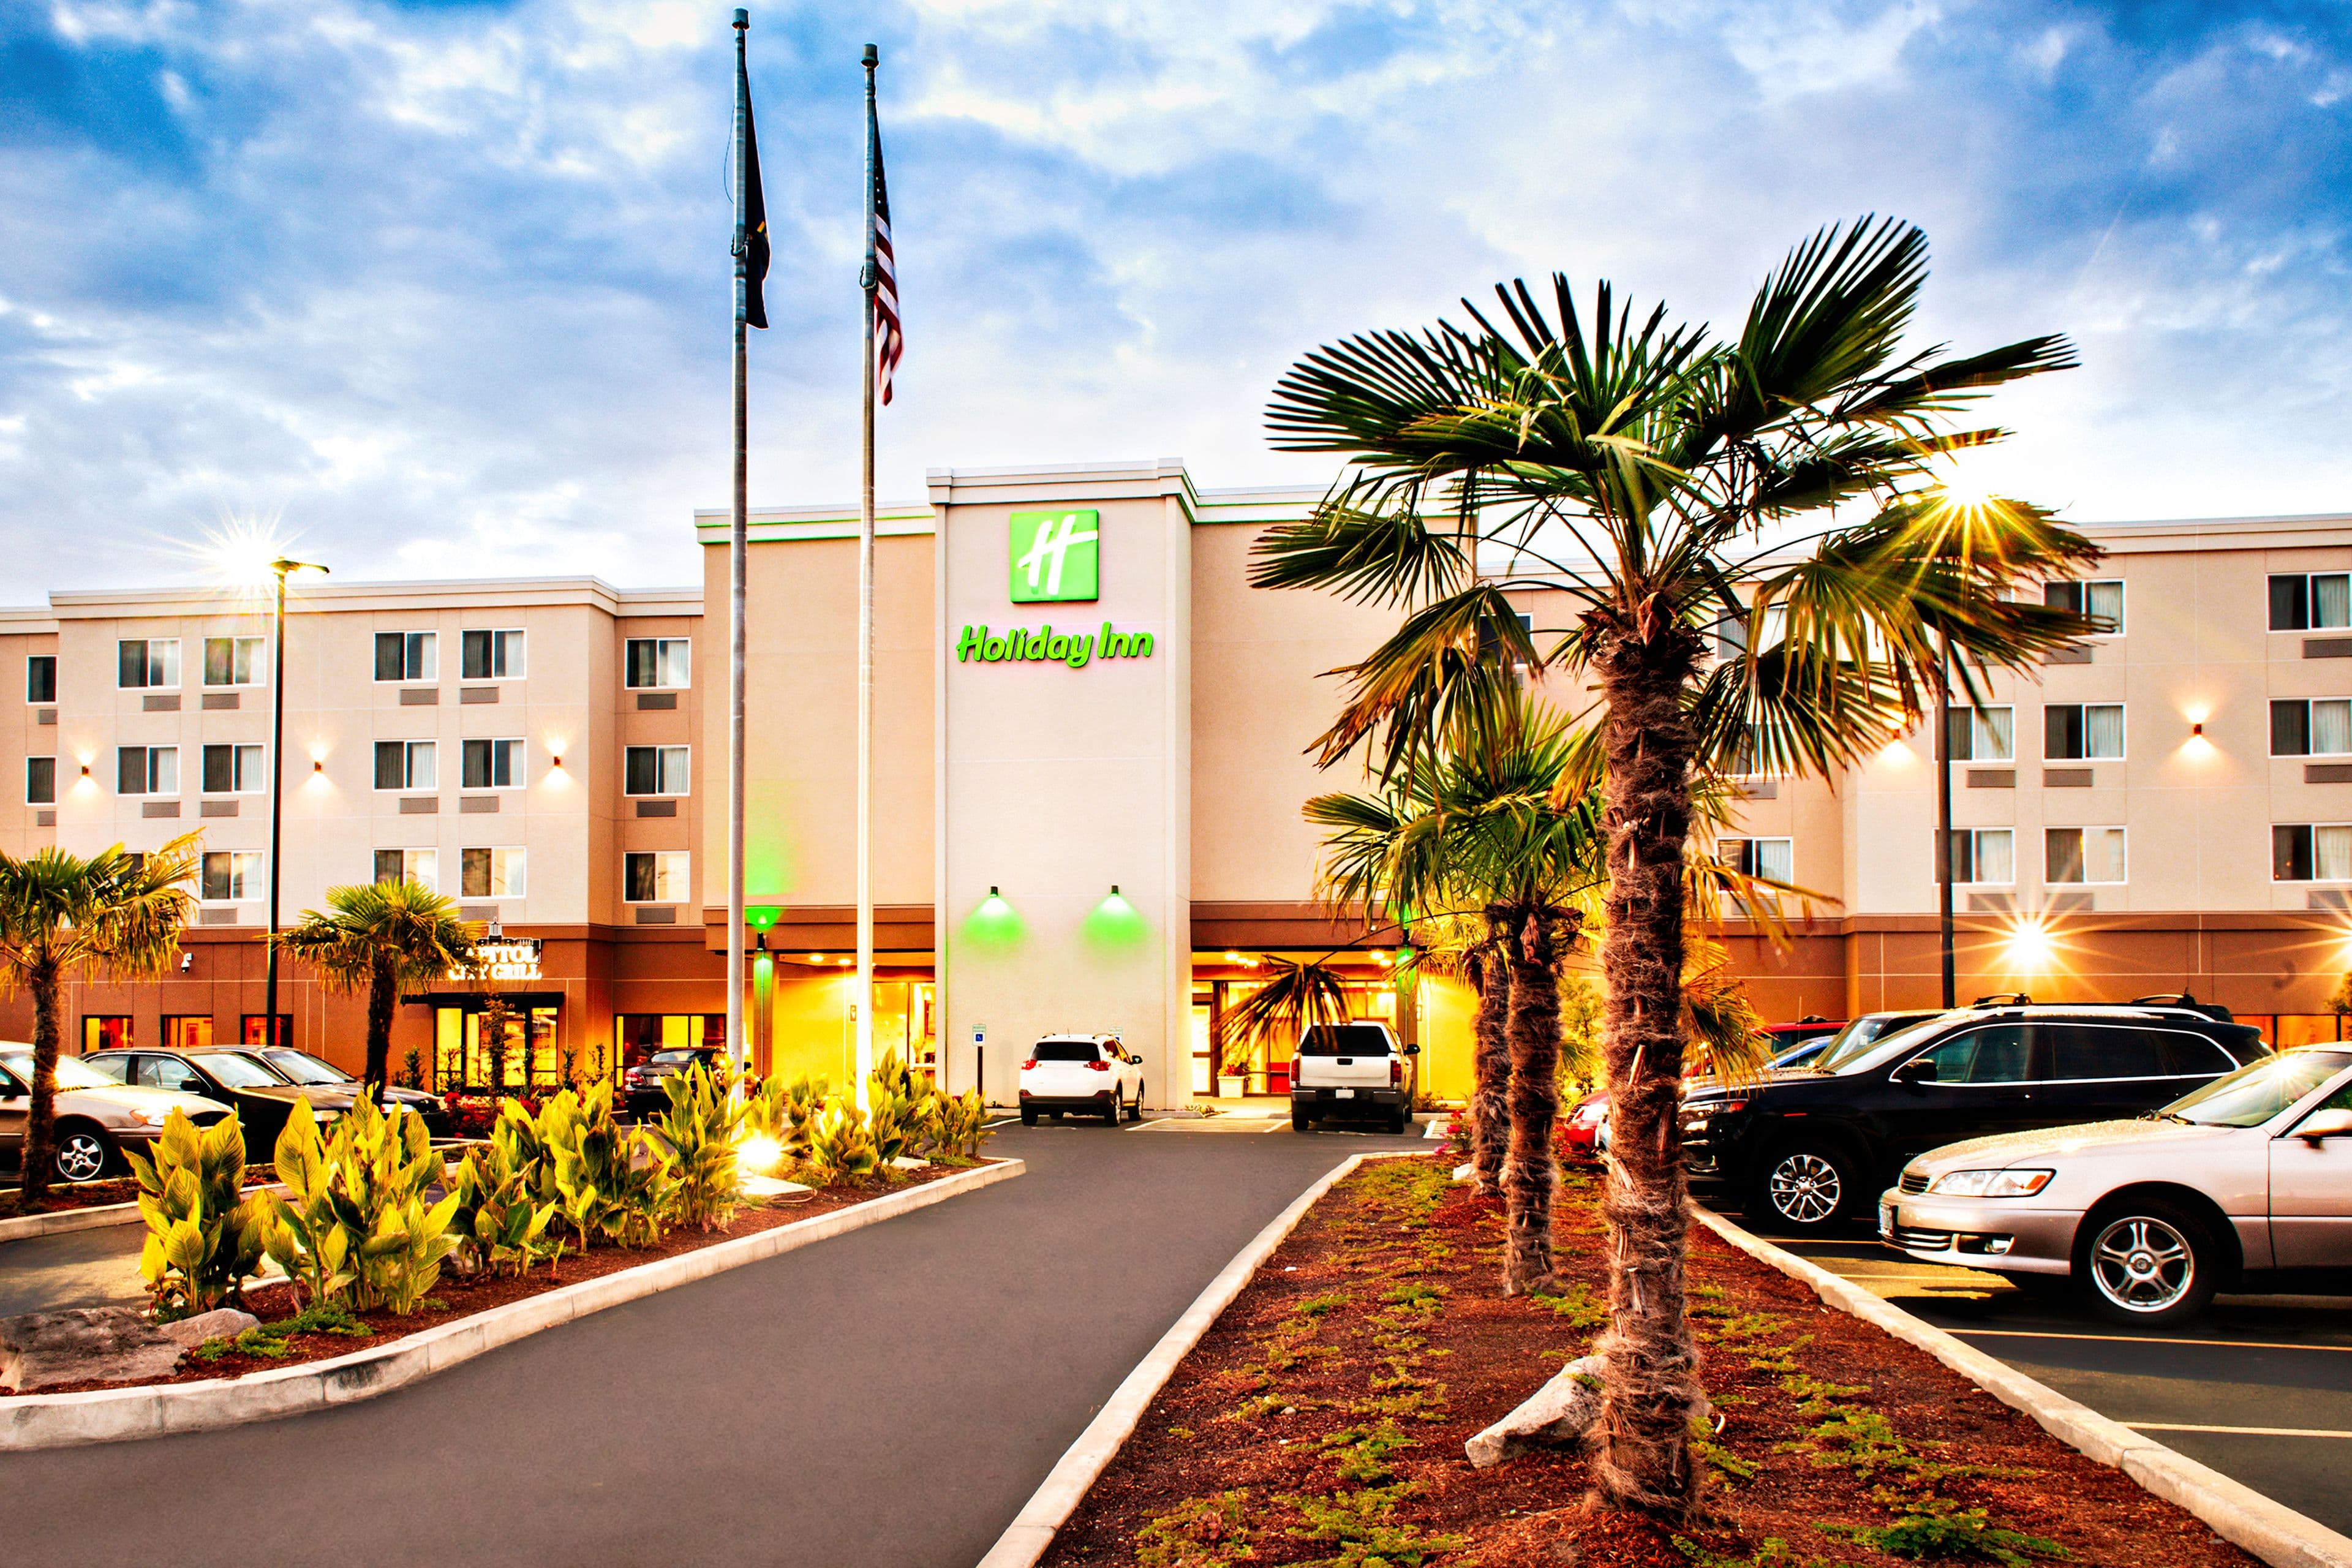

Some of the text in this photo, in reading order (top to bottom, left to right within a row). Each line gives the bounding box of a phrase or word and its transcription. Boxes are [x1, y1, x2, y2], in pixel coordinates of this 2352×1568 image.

[956, 622, 1154, 668] Holiday Inn
[456, 946, 539, 963] PITOL
[491, 963, 542, 980] GRILL
